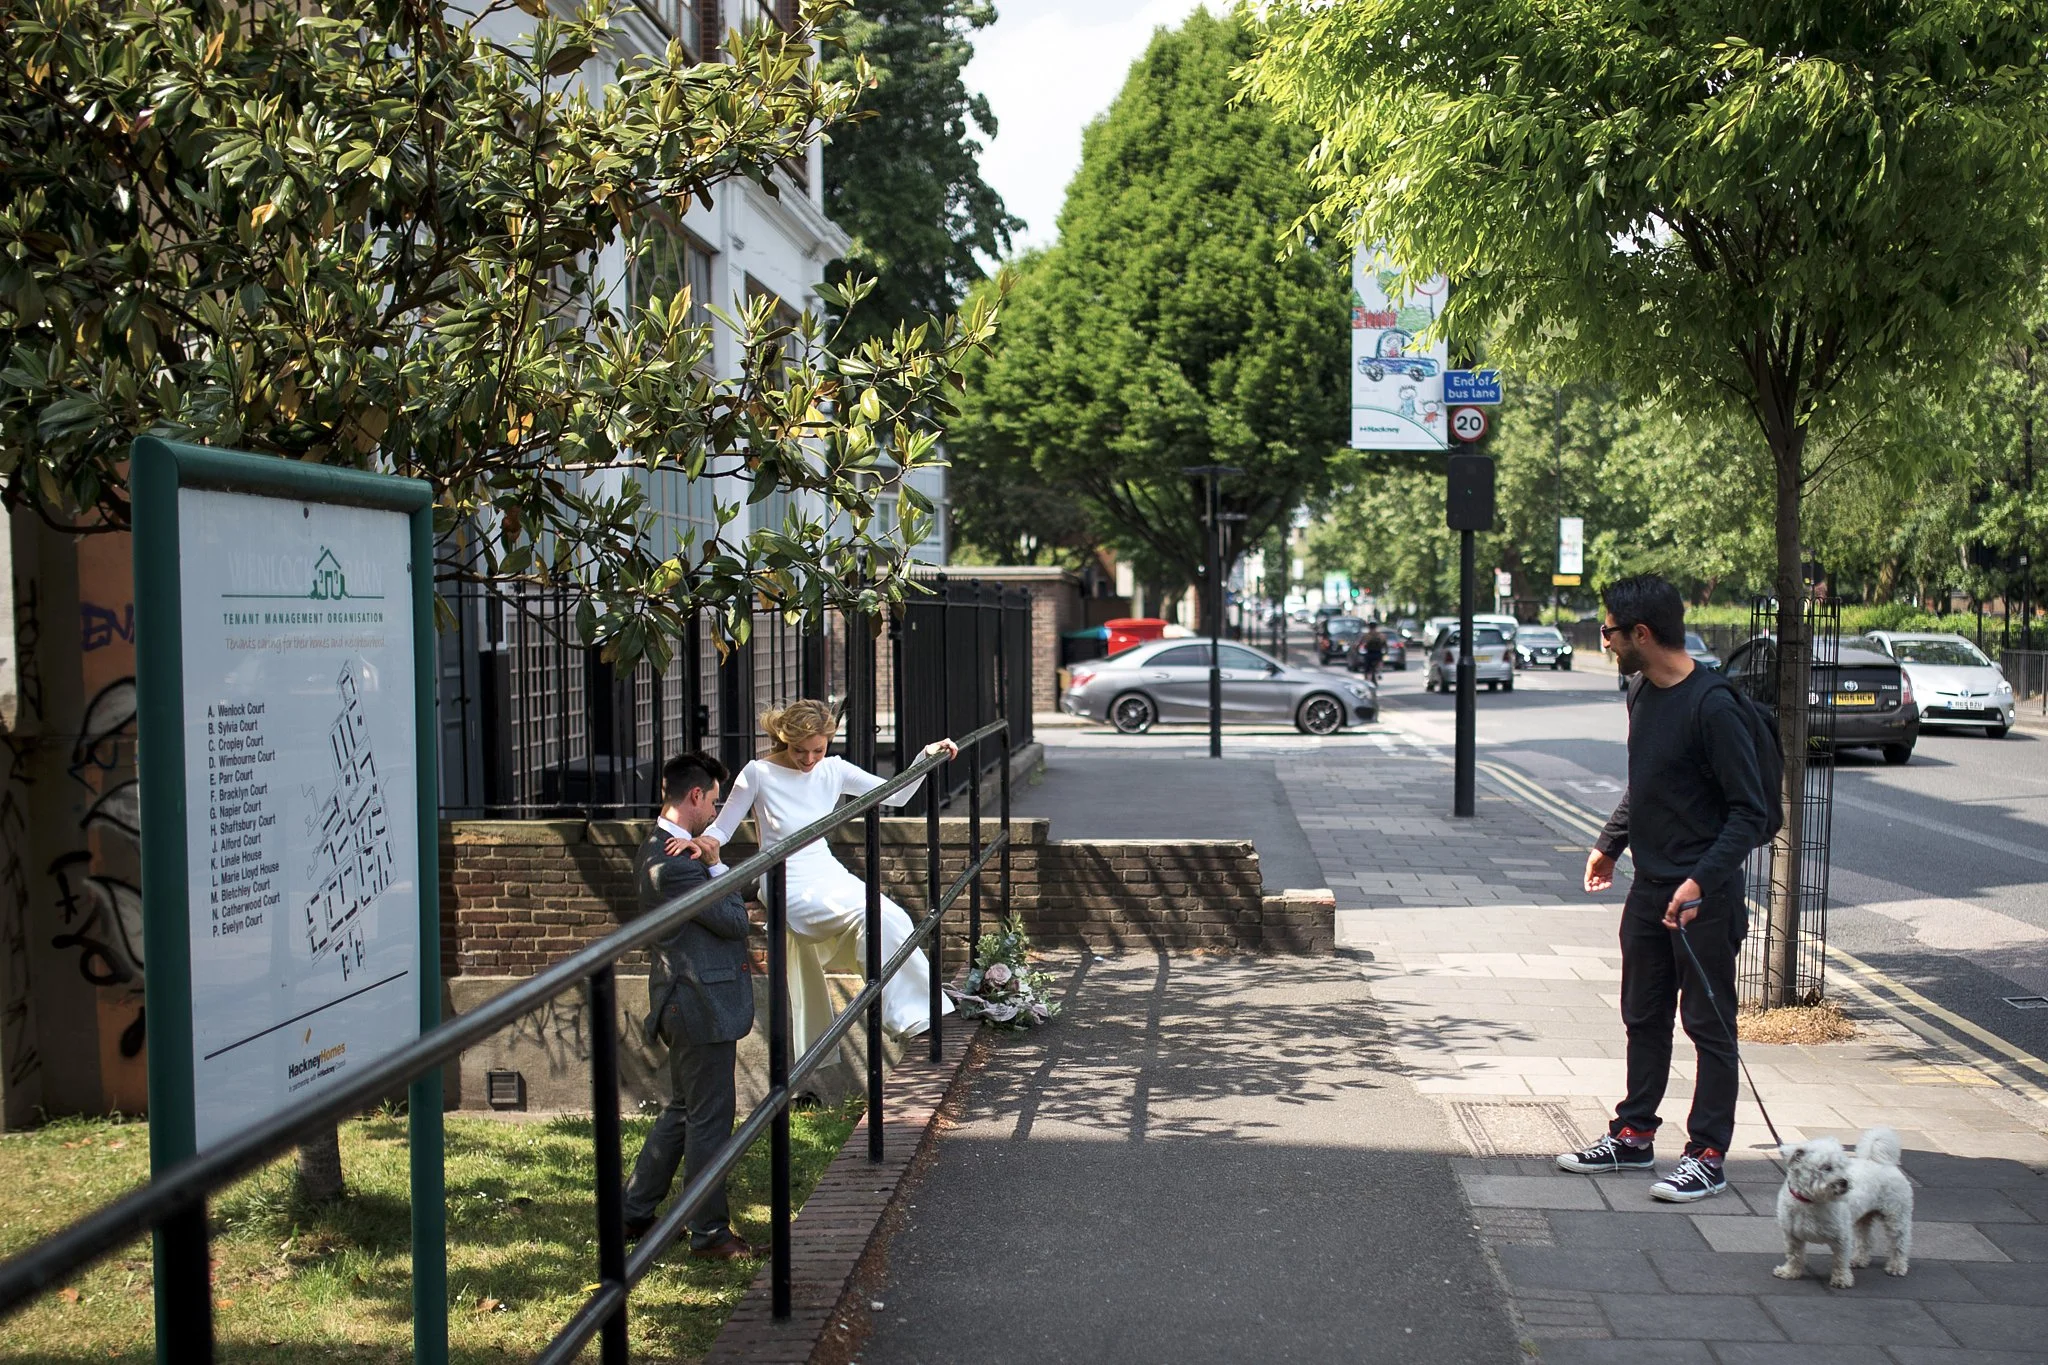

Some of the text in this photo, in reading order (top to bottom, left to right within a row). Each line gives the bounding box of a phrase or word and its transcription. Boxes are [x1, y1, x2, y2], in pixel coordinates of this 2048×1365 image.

[1453, 375, 1491, 387] End of
[1447, 388, 1496, 399] bus lane
[1456, 416, 1482, 431] 20
[223, 613, 383, 625] TENANT MANAGEMENT ORGANISATION
[225, 637, 256, 650] Tenants
[257, 635, 282, 654] caring
[283, 634, 293, 654] for
[208, 703, 265, 718] A. Wenlock Court
[208, 720, 257, 735] B. Sylvia Court
[208, 736, 264, 753] C. Cropley Court
[209, 751, 275, 768] D. Wimbourne Court
[210, 770, 253, 785] E. Parr Court
[211, 783, 268, 802] F. Bracklyn Court
[210, 801, 261, 819] G. Napier Court
[211, 814, 276, 836] H. Shaftsbury Court
[212, 833, 261, 853] J. Alford Court
[211, 851, 262, 870] K. Linale House
[212, 862, 279, 887] L. Marie Lloyd House
[211, 879, 270, 904] M. Bletchley Court
[212, 892, 280, 921] N. Catherwood Court
[213, 913, 263, 937] P. Evelyn Court
[288, 1043, 345, 1079] HackneyHomes
